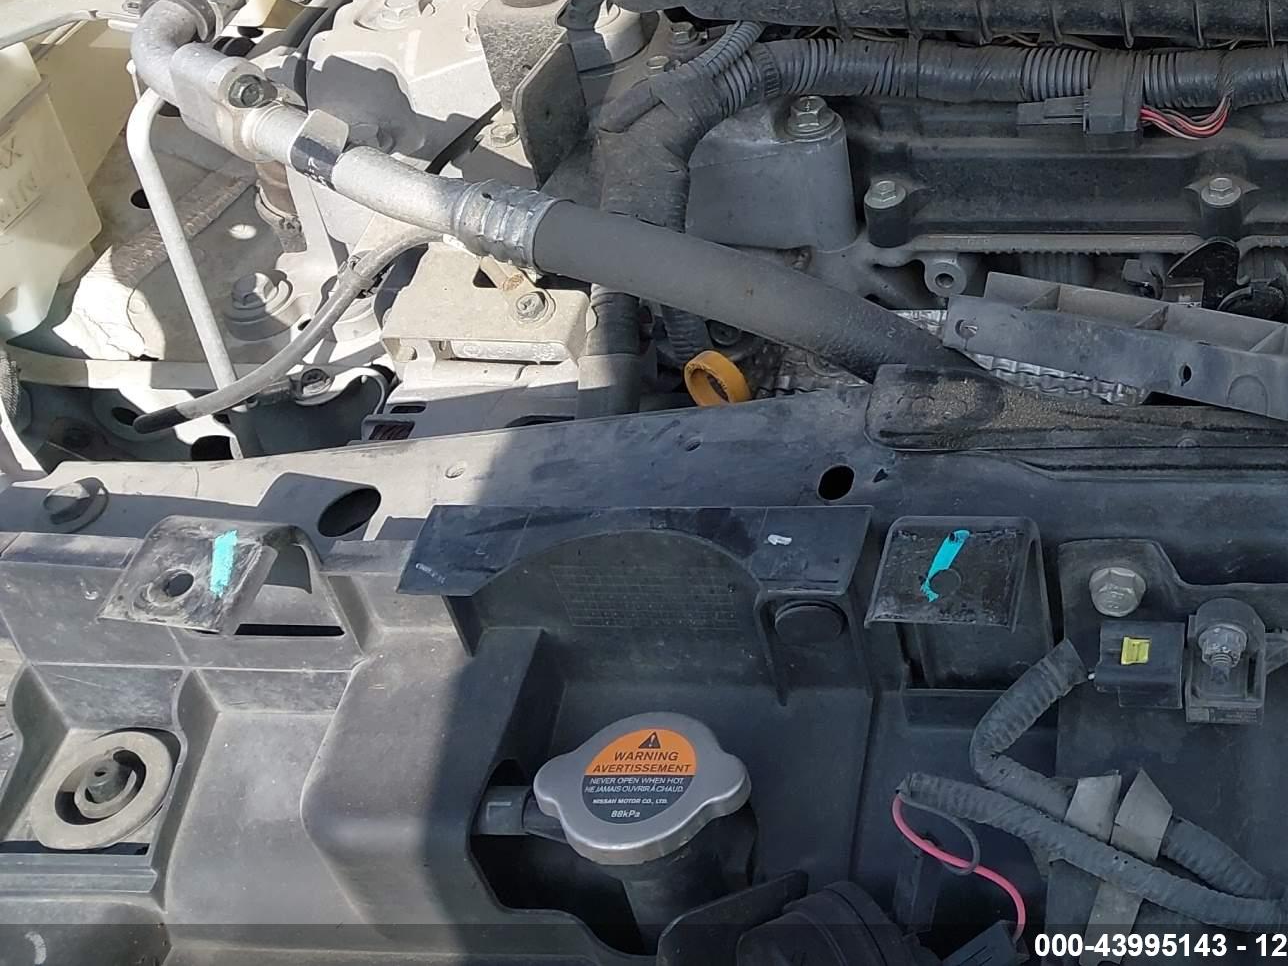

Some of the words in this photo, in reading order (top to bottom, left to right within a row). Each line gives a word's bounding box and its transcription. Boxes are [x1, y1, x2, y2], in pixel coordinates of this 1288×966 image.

[614, 751, 679, 762] WARNING
[592, 764, 692, 774] AVERTISSEMENT
[590, 777, 617, 785] NEVER
[617, 777, 640, 785] OPEN
[611, 810, 641, 818] 88kPa
